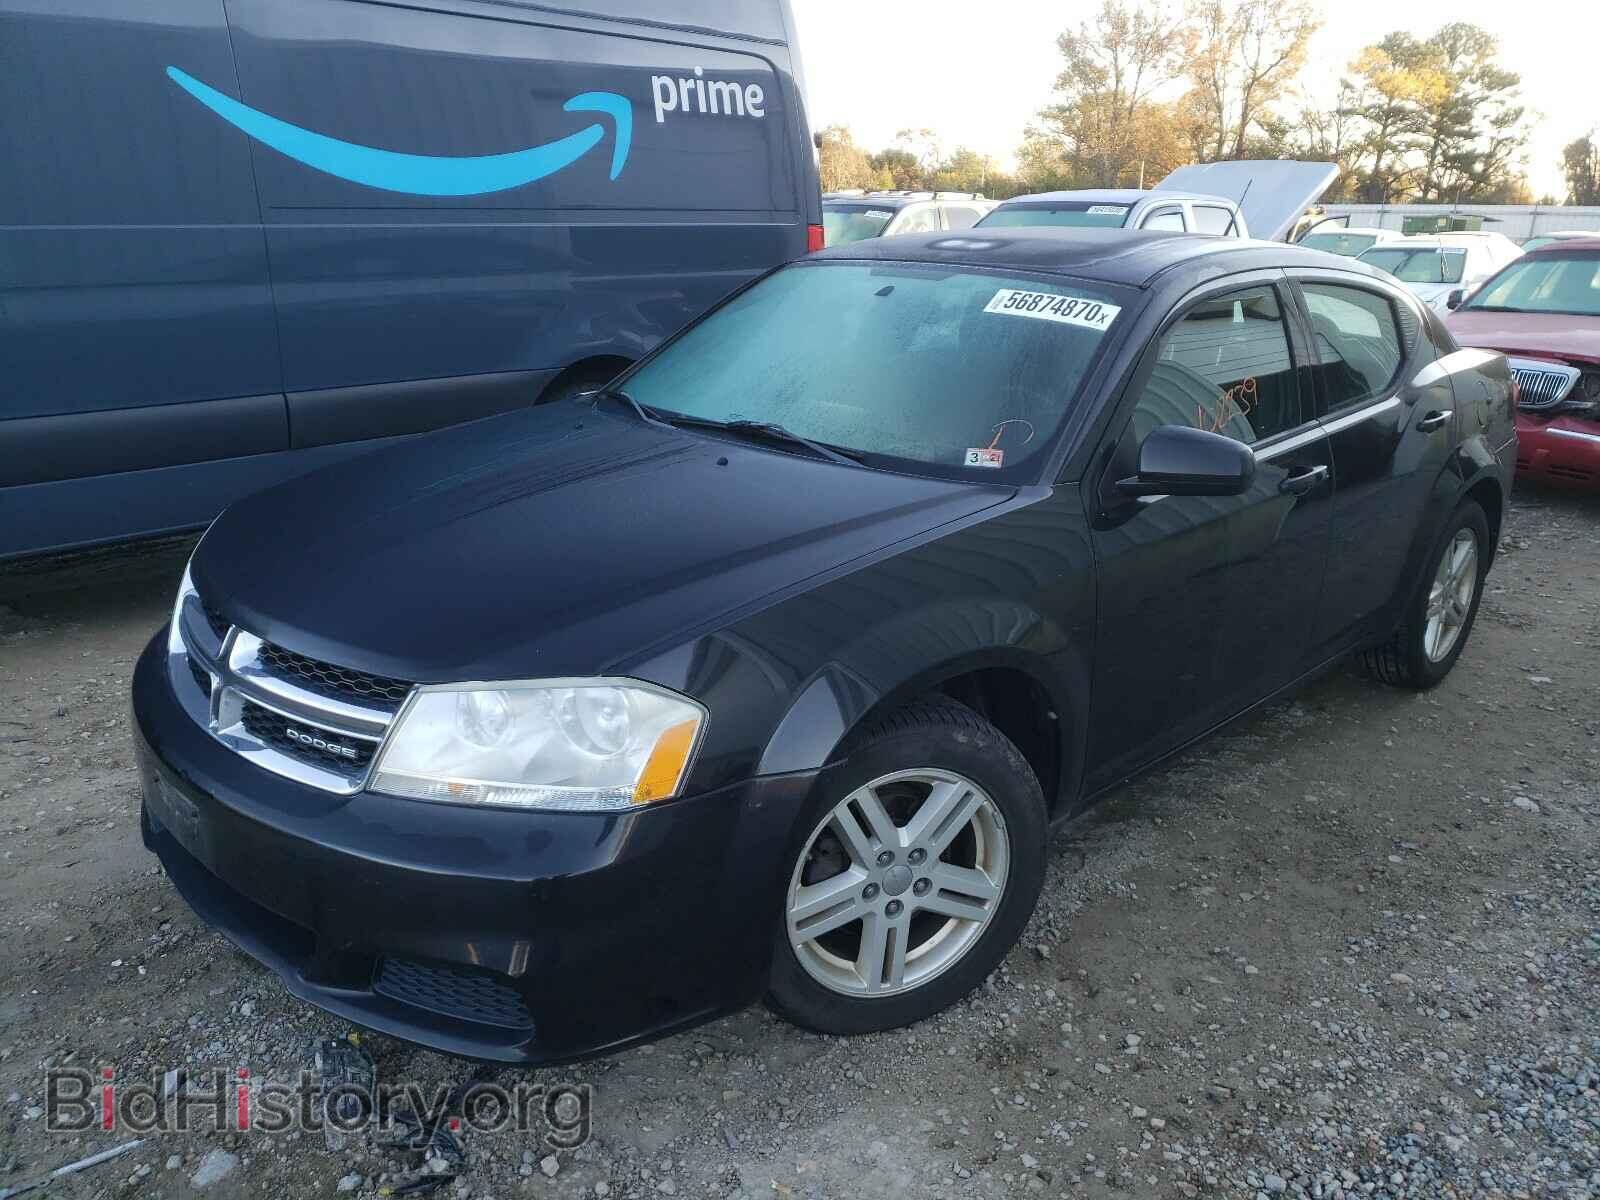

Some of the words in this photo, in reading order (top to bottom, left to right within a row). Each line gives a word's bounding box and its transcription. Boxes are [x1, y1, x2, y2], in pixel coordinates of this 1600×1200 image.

[651, 65, 765, 123] prime
[970, 452, 979, 463] 3
[286, 728, 356, 759] DODGE
